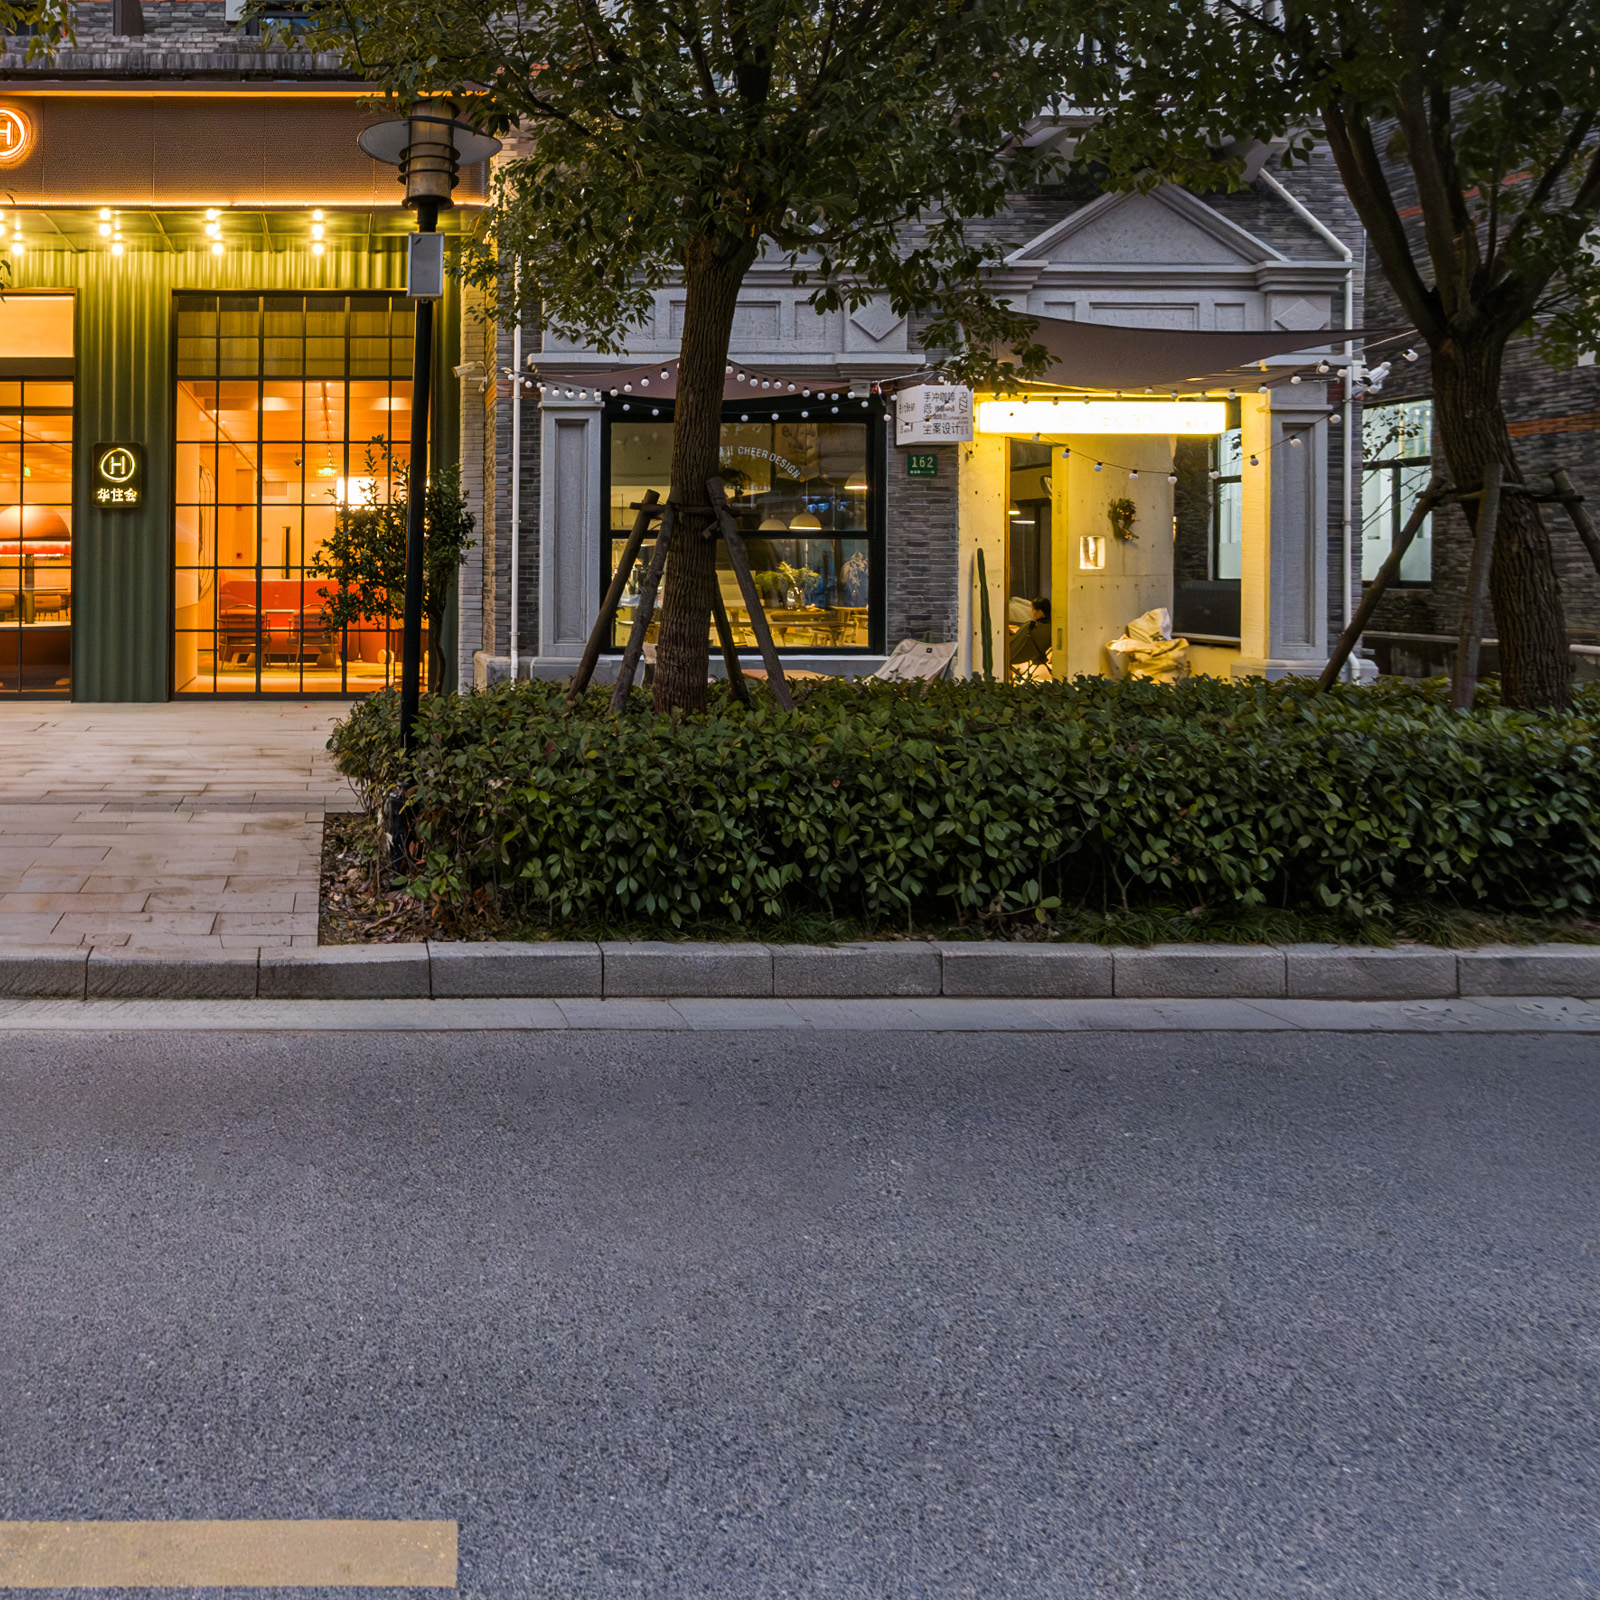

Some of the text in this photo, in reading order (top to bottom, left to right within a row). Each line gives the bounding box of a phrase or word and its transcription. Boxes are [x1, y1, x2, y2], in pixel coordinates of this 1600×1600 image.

[959, 391, 968, 414] PIZZA
[737, 445, 769, 459] CHEER
[769, 452, 800, 479] DESIGN
[911, 456, 934, 468] 162
[97, 487, 138, 502] 华住会
